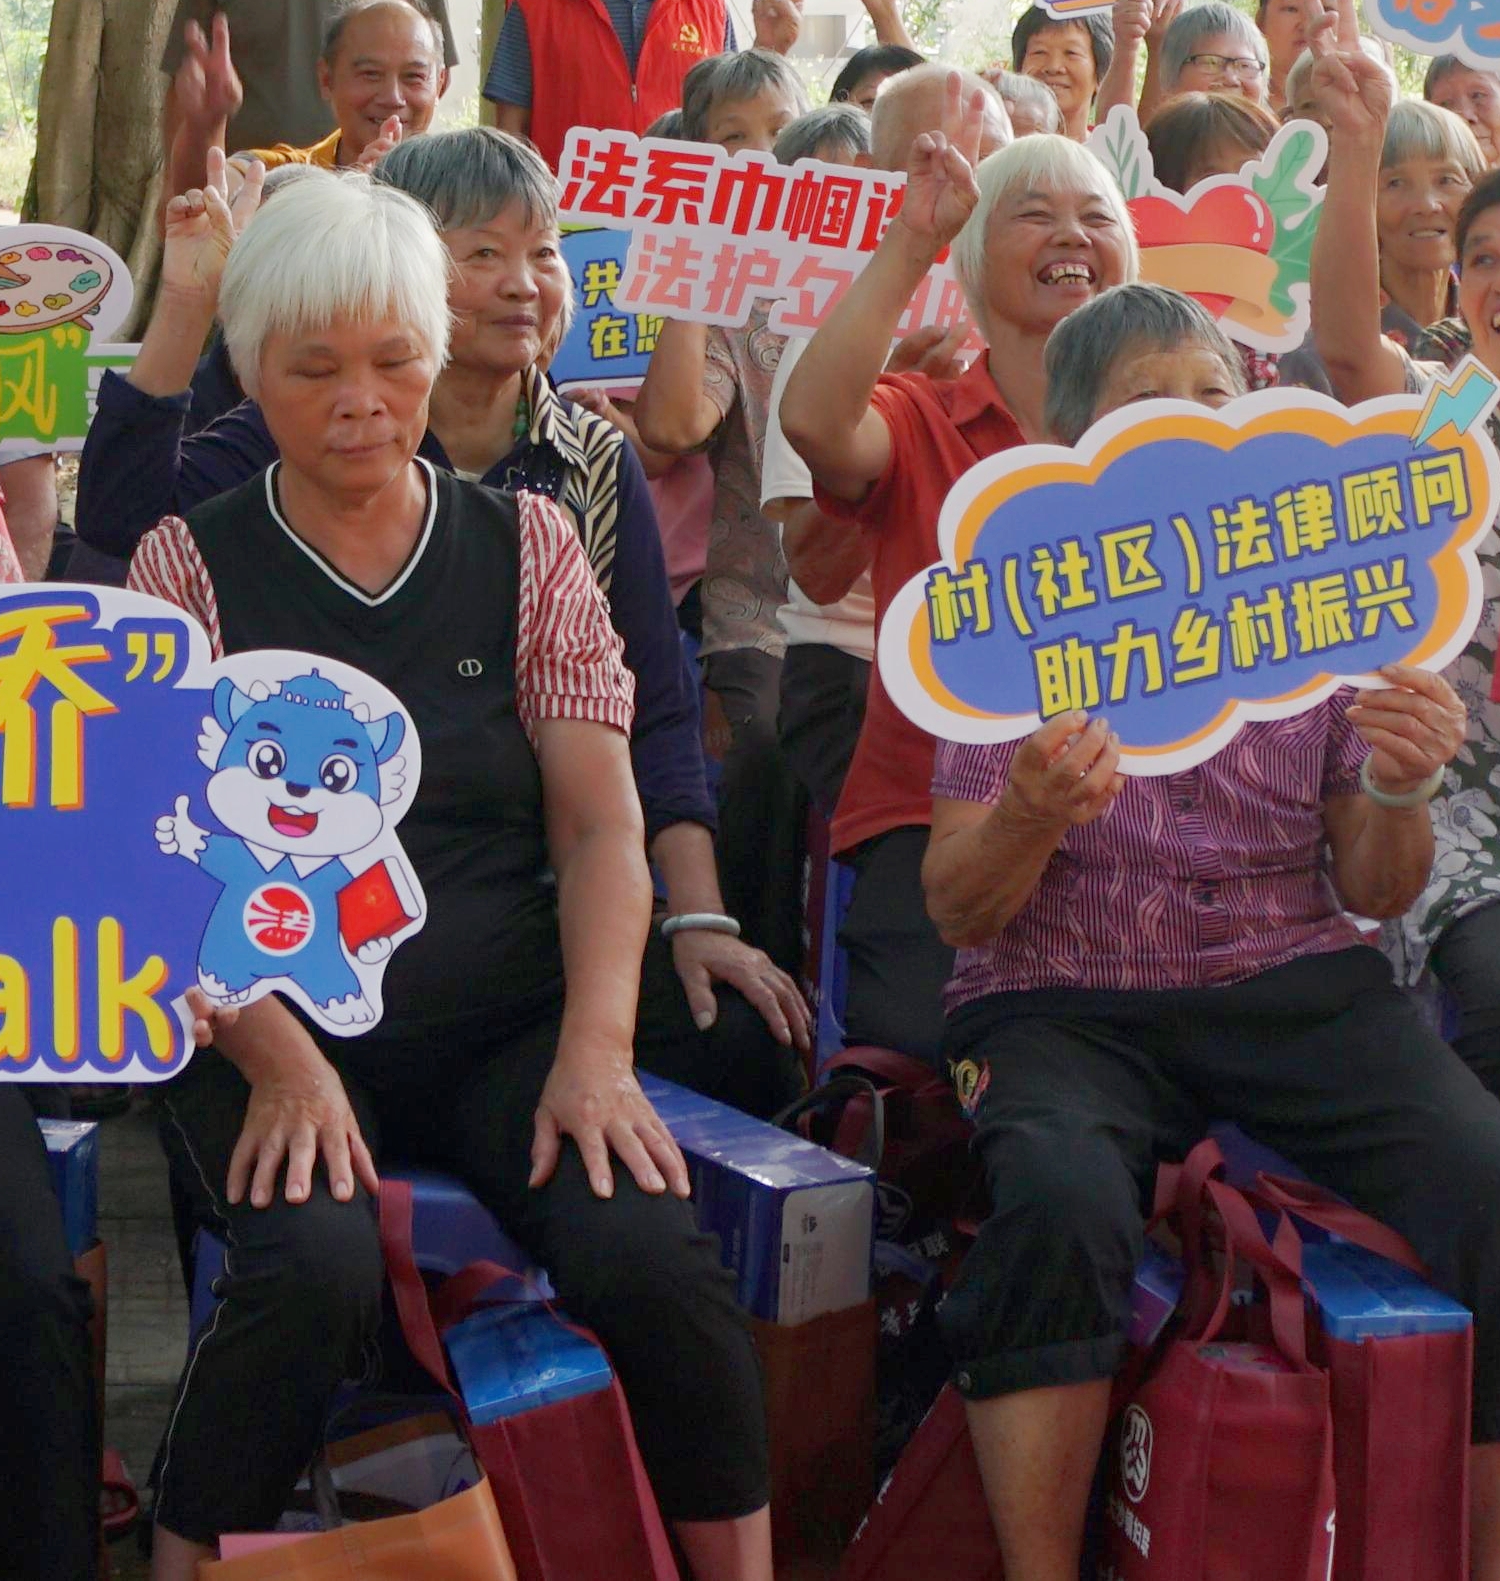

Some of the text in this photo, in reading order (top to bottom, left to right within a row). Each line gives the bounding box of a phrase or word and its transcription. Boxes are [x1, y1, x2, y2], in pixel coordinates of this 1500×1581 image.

[1032, 557, 1415, 718] 助力乡村振兴
